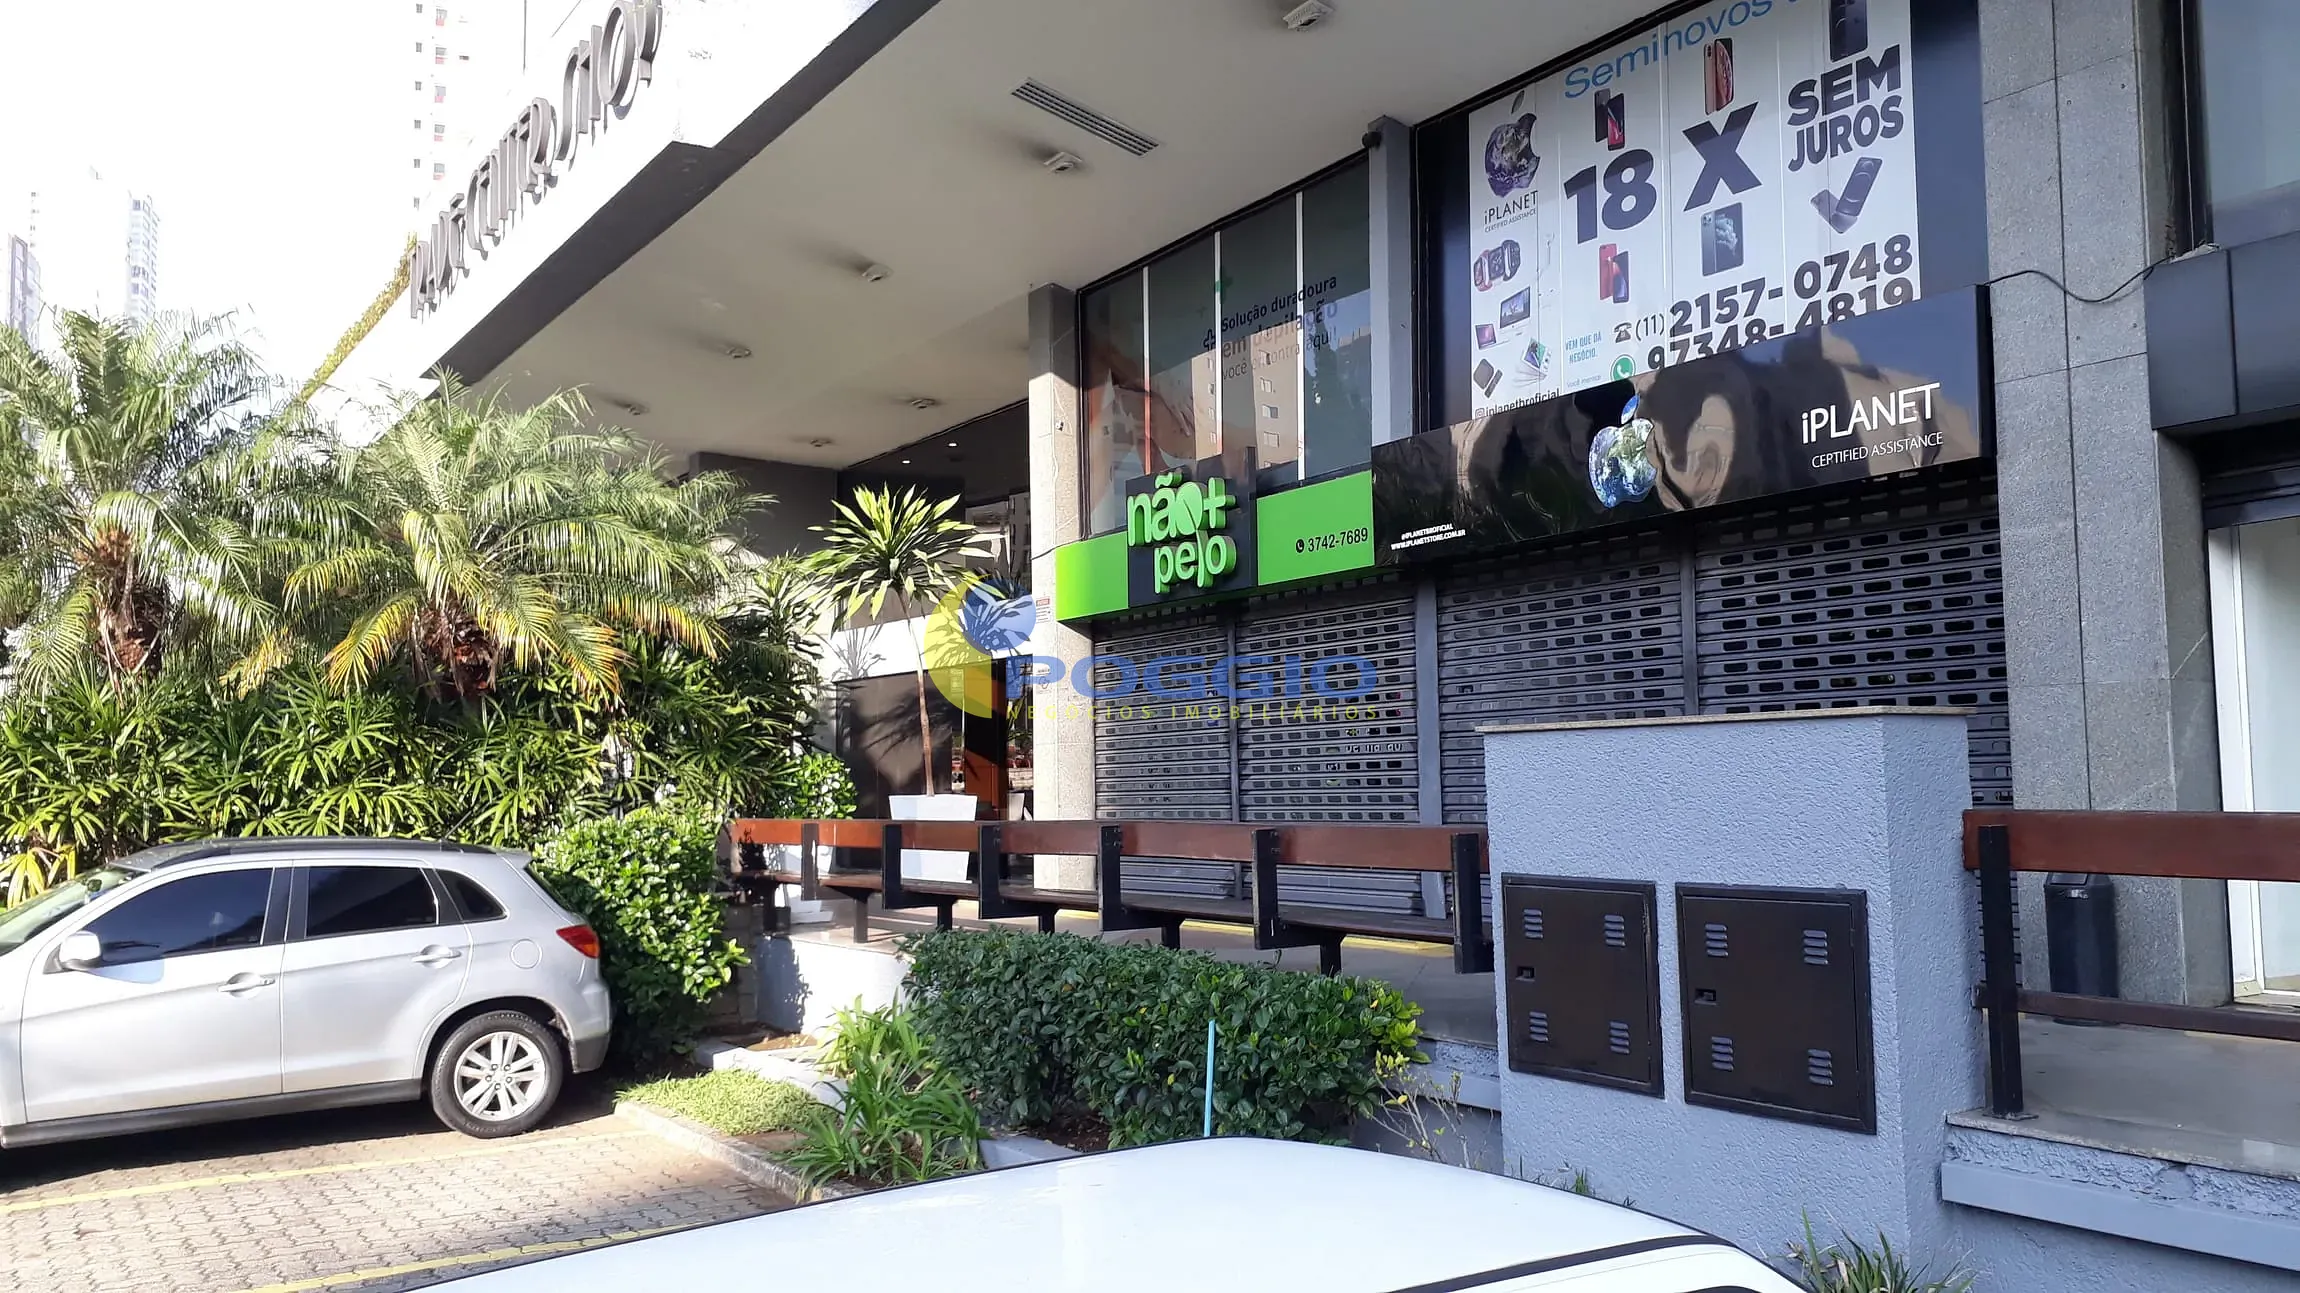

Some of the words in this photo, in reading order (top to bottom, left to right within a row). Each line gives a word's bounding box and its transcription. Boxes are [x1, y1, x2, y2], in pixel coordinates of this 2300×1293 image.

[1565, 0, 1772, 99] Seminovos
[1787, 44, 1901, 126] SEM
[1788, 95, 1904, 172] JUROS
[1564, 149, 1657, 244] 18
[1682, 102, 1762, 211] X
[1484, 190, 1538, 225] iPLANET
[1222, 304, 1267, 331] Solução
[1271, 276, 1337, 314] duradoura
[1635, 314, 1665, 341] (11)
[1224, 336, 1247, 358] em
[1580, 335, 1592, 347] QUE
[1801, 382, 1941, 444] iPLANET
[1811, 446, 1869, 469] CERTIFIED
[1871, 431, 1944, 457] ASSISTANCE
[1154, 535, 1234, 594] pelo
[1307, 527, 1369, 552] 3742-7689
